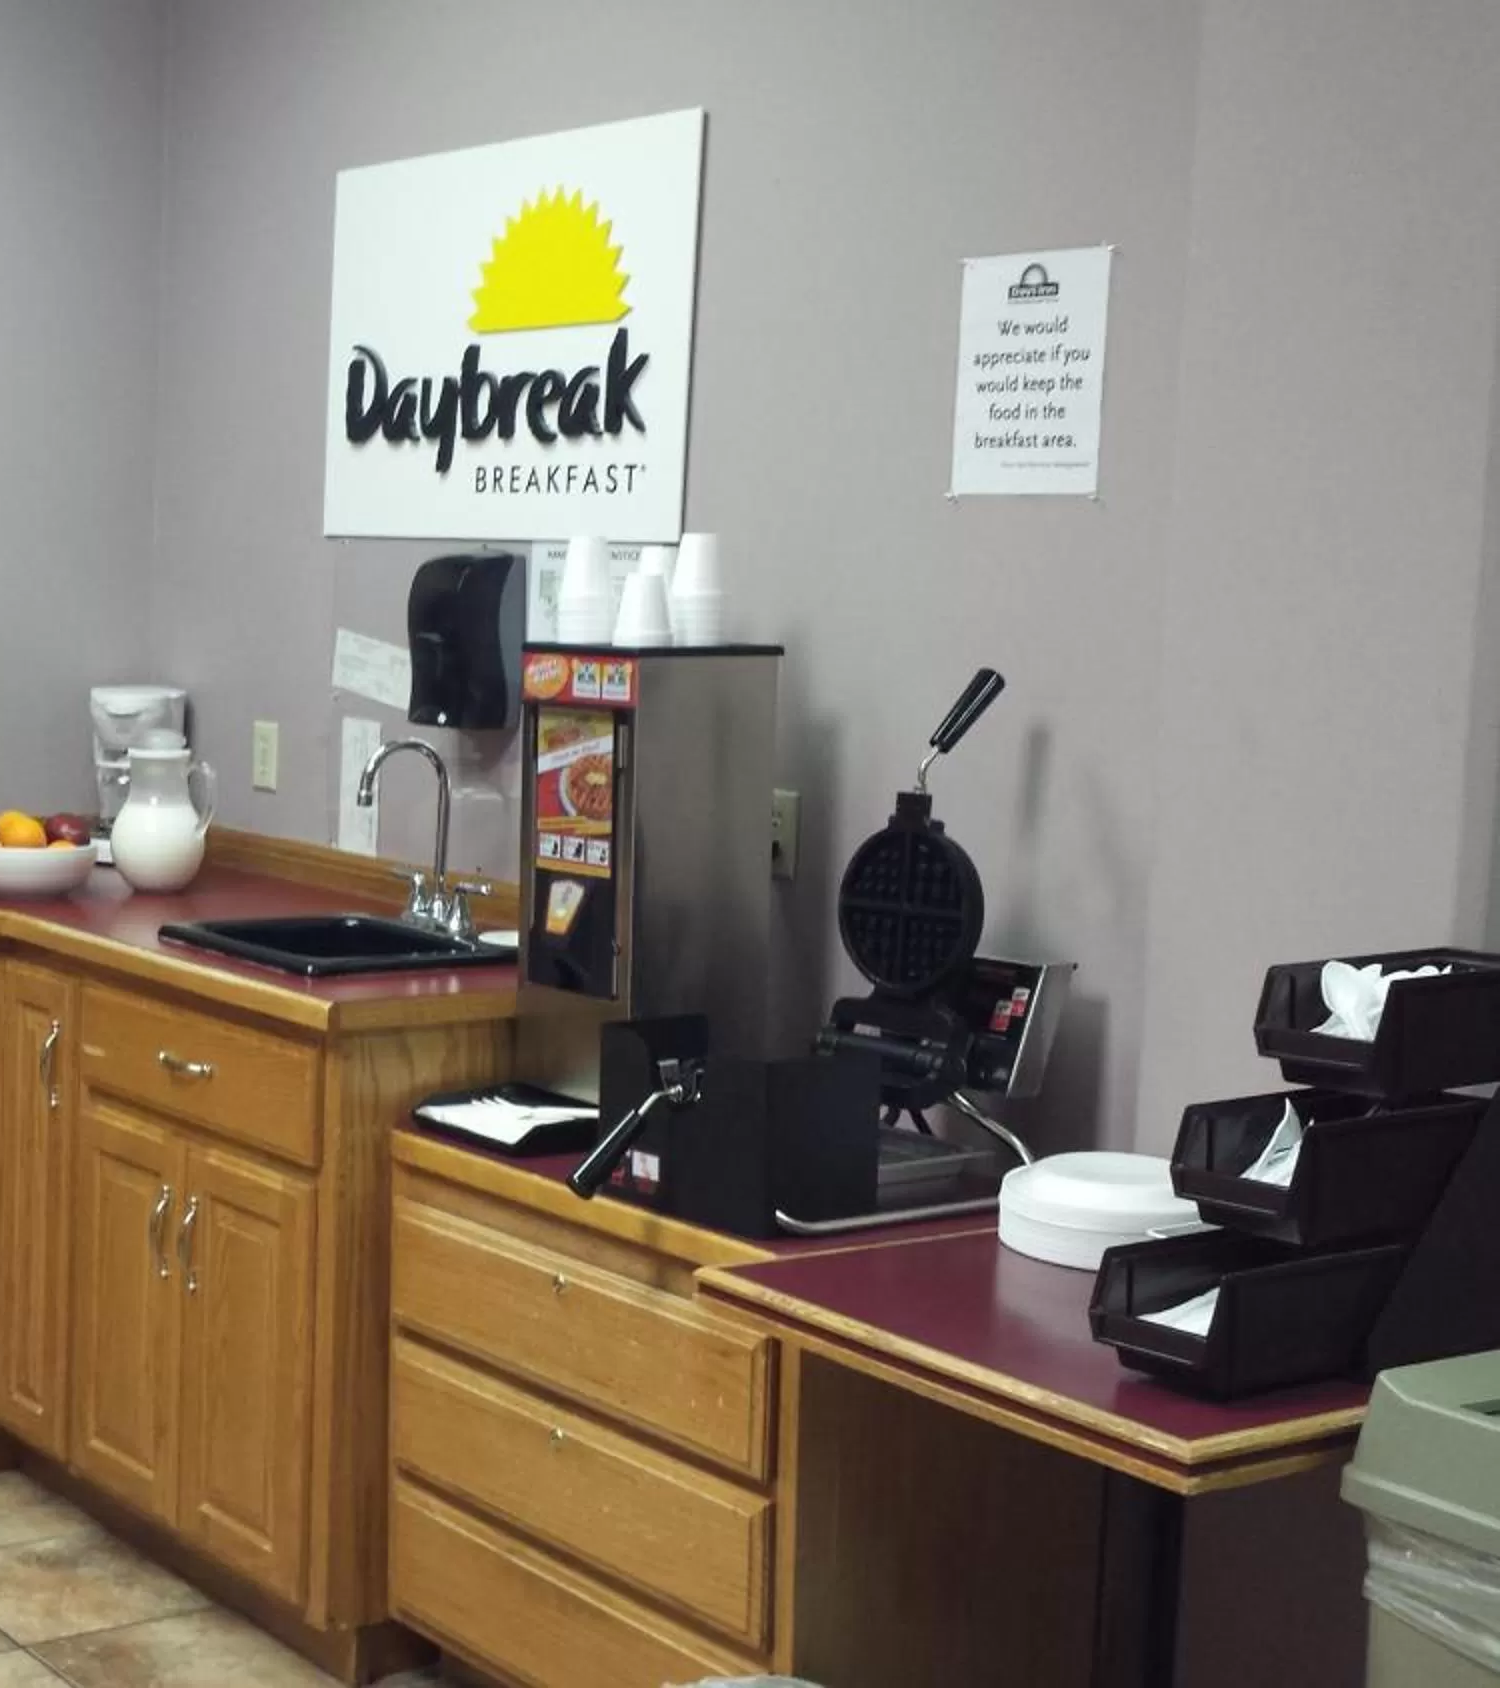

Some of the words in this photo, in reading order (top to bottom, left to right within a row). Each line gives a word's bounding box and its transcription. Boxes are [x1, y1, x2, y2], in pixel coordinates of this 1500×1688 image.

[997, 319, 1020, 336] We
[1023, 315, 1069, 335] would
[973, 347, 1046, 370] appreciate
[1051, 342, 1062, 361] if
[1063, 347, 1090, 367] you
[975, 375, 1019, 394] would
[1022, 372, 1056, 394] keep
[1060, 373, 1084, 391] the
[345, 327, 650, 473] Daybreak
[988, 402, 1021, 421] food
[1025, 403, 1038, 420] in
[1043, 401, 1066, 420] the
[974, 429, 1038, 449] breakfast
[1042, 434, 1077, 449] area.
[474, 464, 638, 494] BREAKFAST
